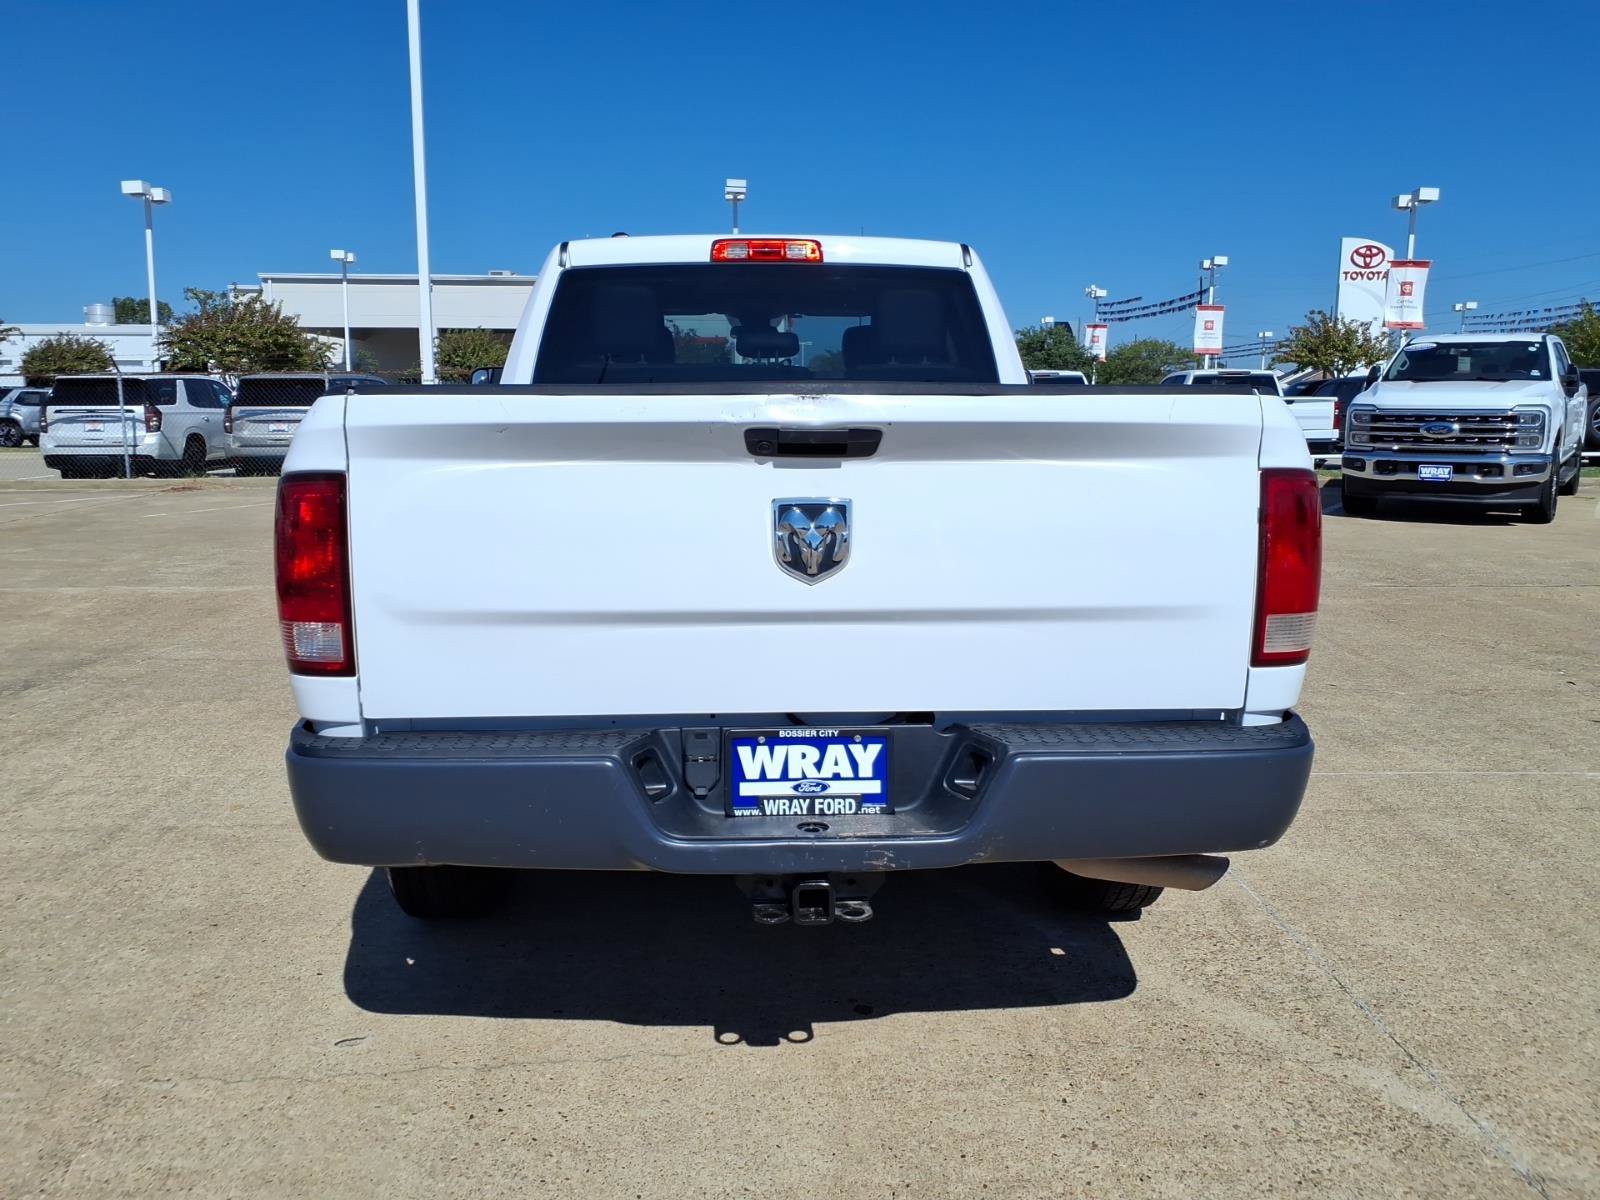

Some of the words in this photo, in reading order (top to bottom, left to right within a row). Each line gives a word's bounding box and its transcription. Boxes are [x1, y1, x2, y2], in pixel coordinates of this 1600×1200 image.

[1342, 270, 1389, 281] TOYOTA
[1420, 467, 1451, 475] WRAY
[779, 730, 819, 738] BOSSIER
[819, 729, 839, 737] CITY
[736, 743, 883, 780] WRAY
[798, 781, 822, 793] Ford
[763, 799, 811, 815] WRAY
[814, 798, 856, 815] FORD
